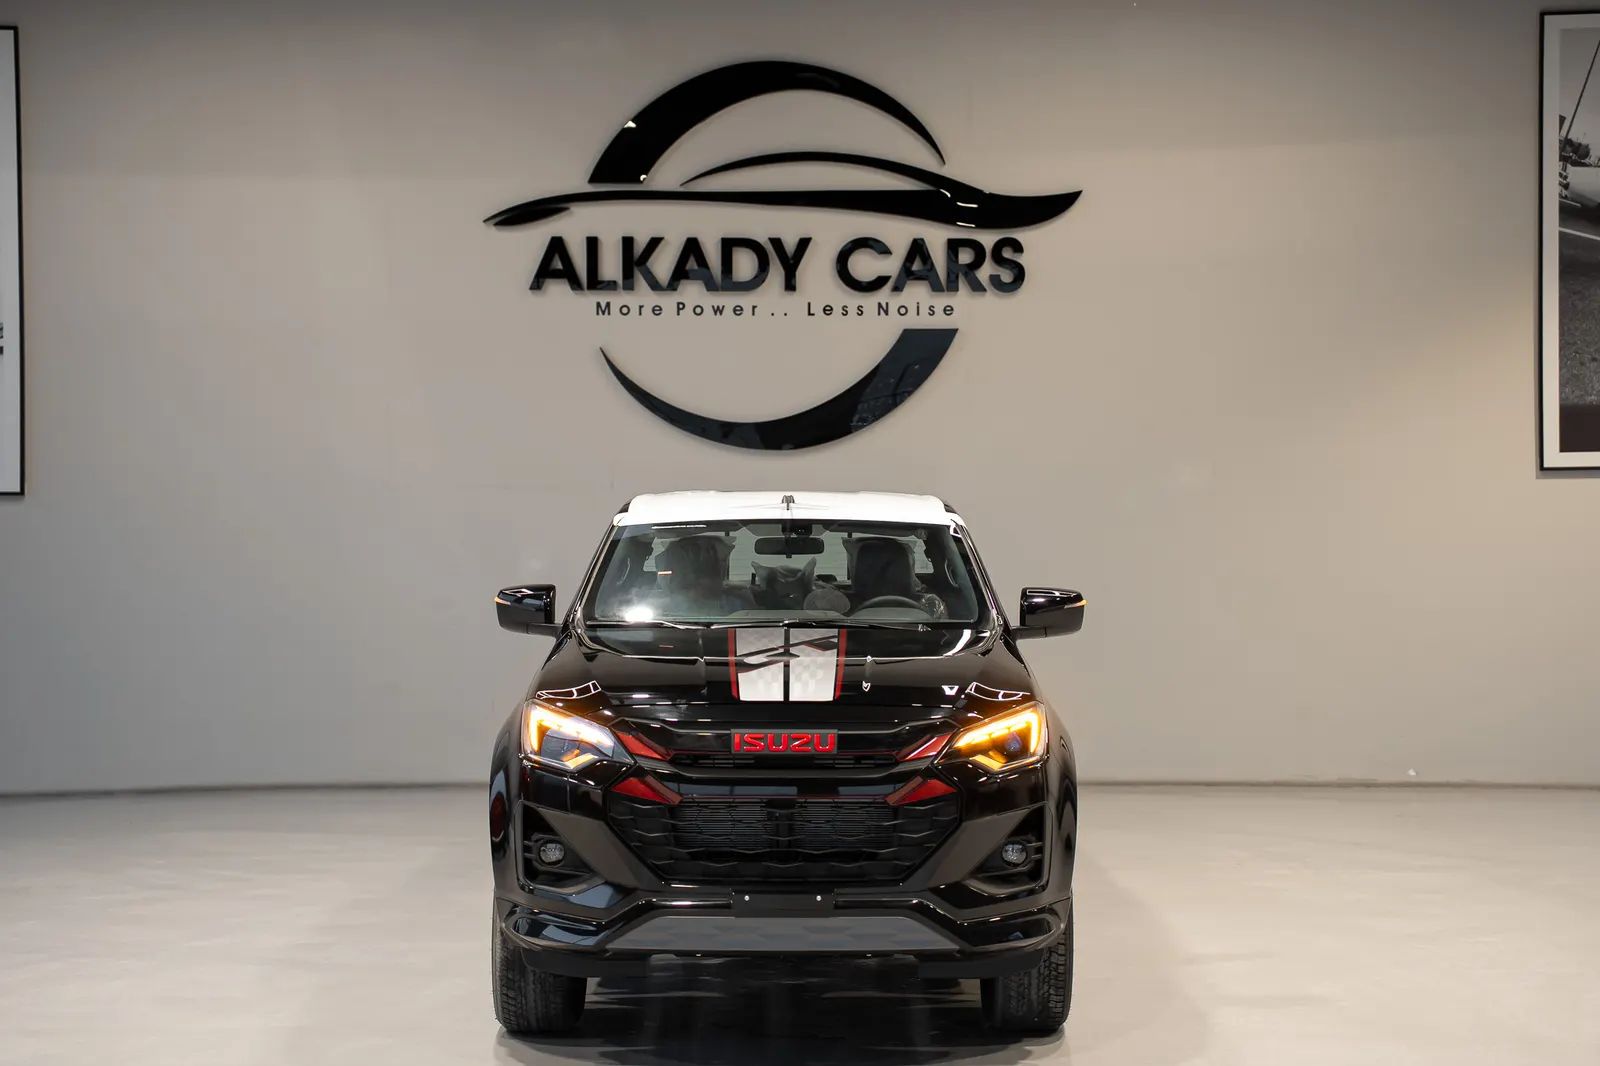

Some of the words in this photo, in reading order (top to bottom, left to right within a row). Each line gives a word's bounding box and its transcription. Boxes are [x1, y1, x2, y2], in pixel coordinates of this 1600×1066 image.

[529, 235, 813, 293] ALKADY
[835, 236, 1026, 294] CARS
[595, 301, 663, 317] More
[807, 301, 864, 317] Less
[877, 301, 955, 317] Noise
[733, 732, 836, 753] ISUZU
